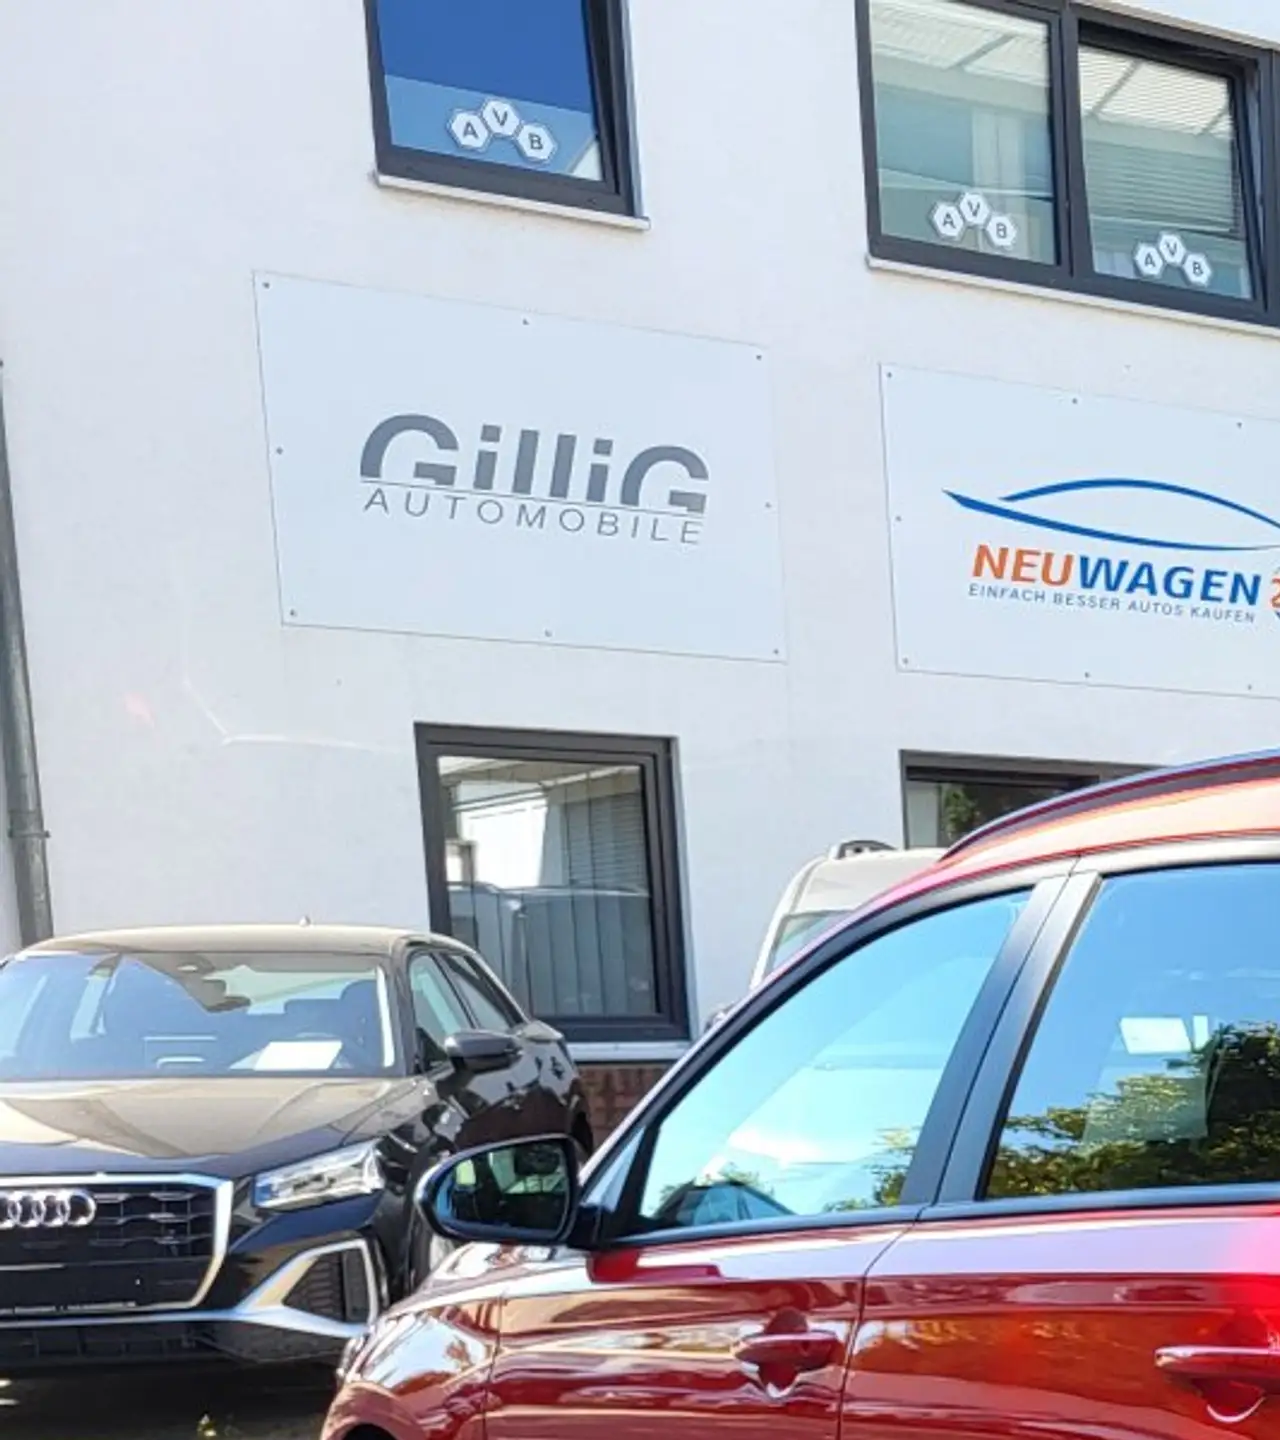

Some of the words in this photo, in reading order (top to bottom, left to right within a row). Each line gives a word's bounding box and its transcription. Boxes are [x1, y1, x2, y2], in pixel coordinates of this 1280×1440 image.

[363, 487, 706, 545] AUTOMOBILE
[968, 583, 1046, 603] EINFACH
[1053, 591, 1121, 611] BESSER
[1127, 602, 1183, 617] AUTOS
[1190, 606, 1256, 623] KAUFEN
